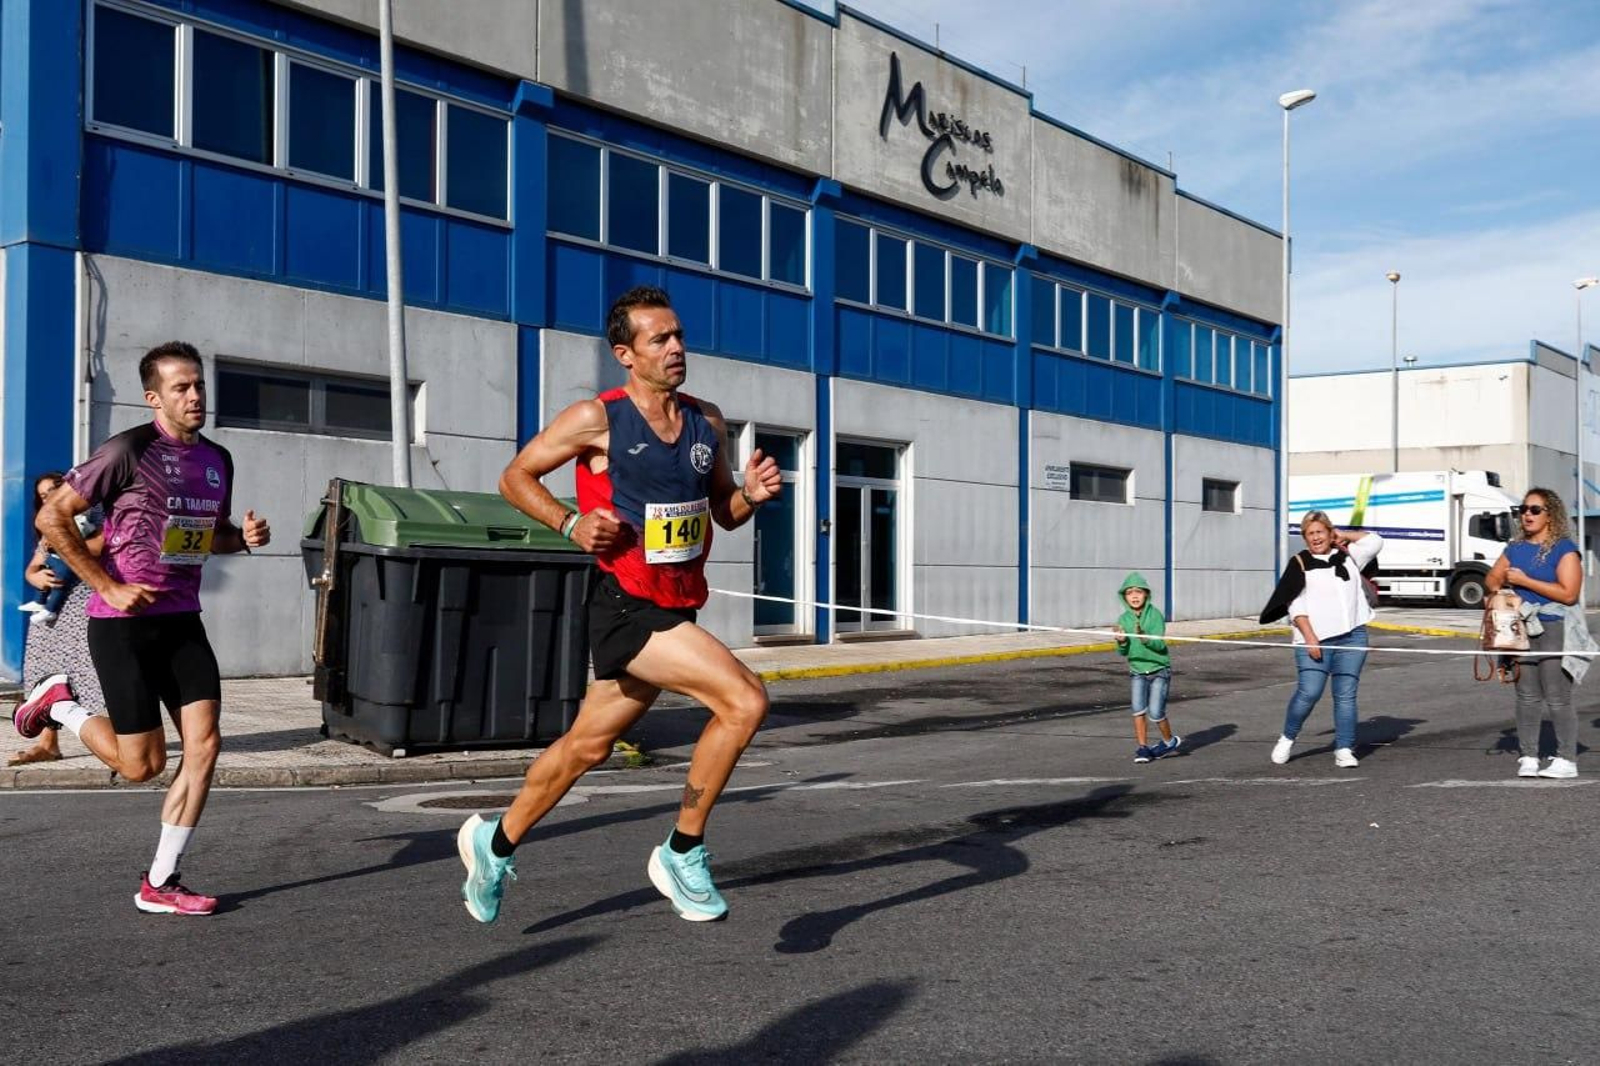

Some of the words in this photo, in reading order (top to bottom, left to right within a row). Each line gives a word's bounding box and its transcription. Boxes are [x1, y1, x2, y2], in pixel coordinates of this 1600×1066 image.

[167, 496, 182, 510] CA
[181, 530, 204, 550] 32
[663, 517, 701, 544] 140
